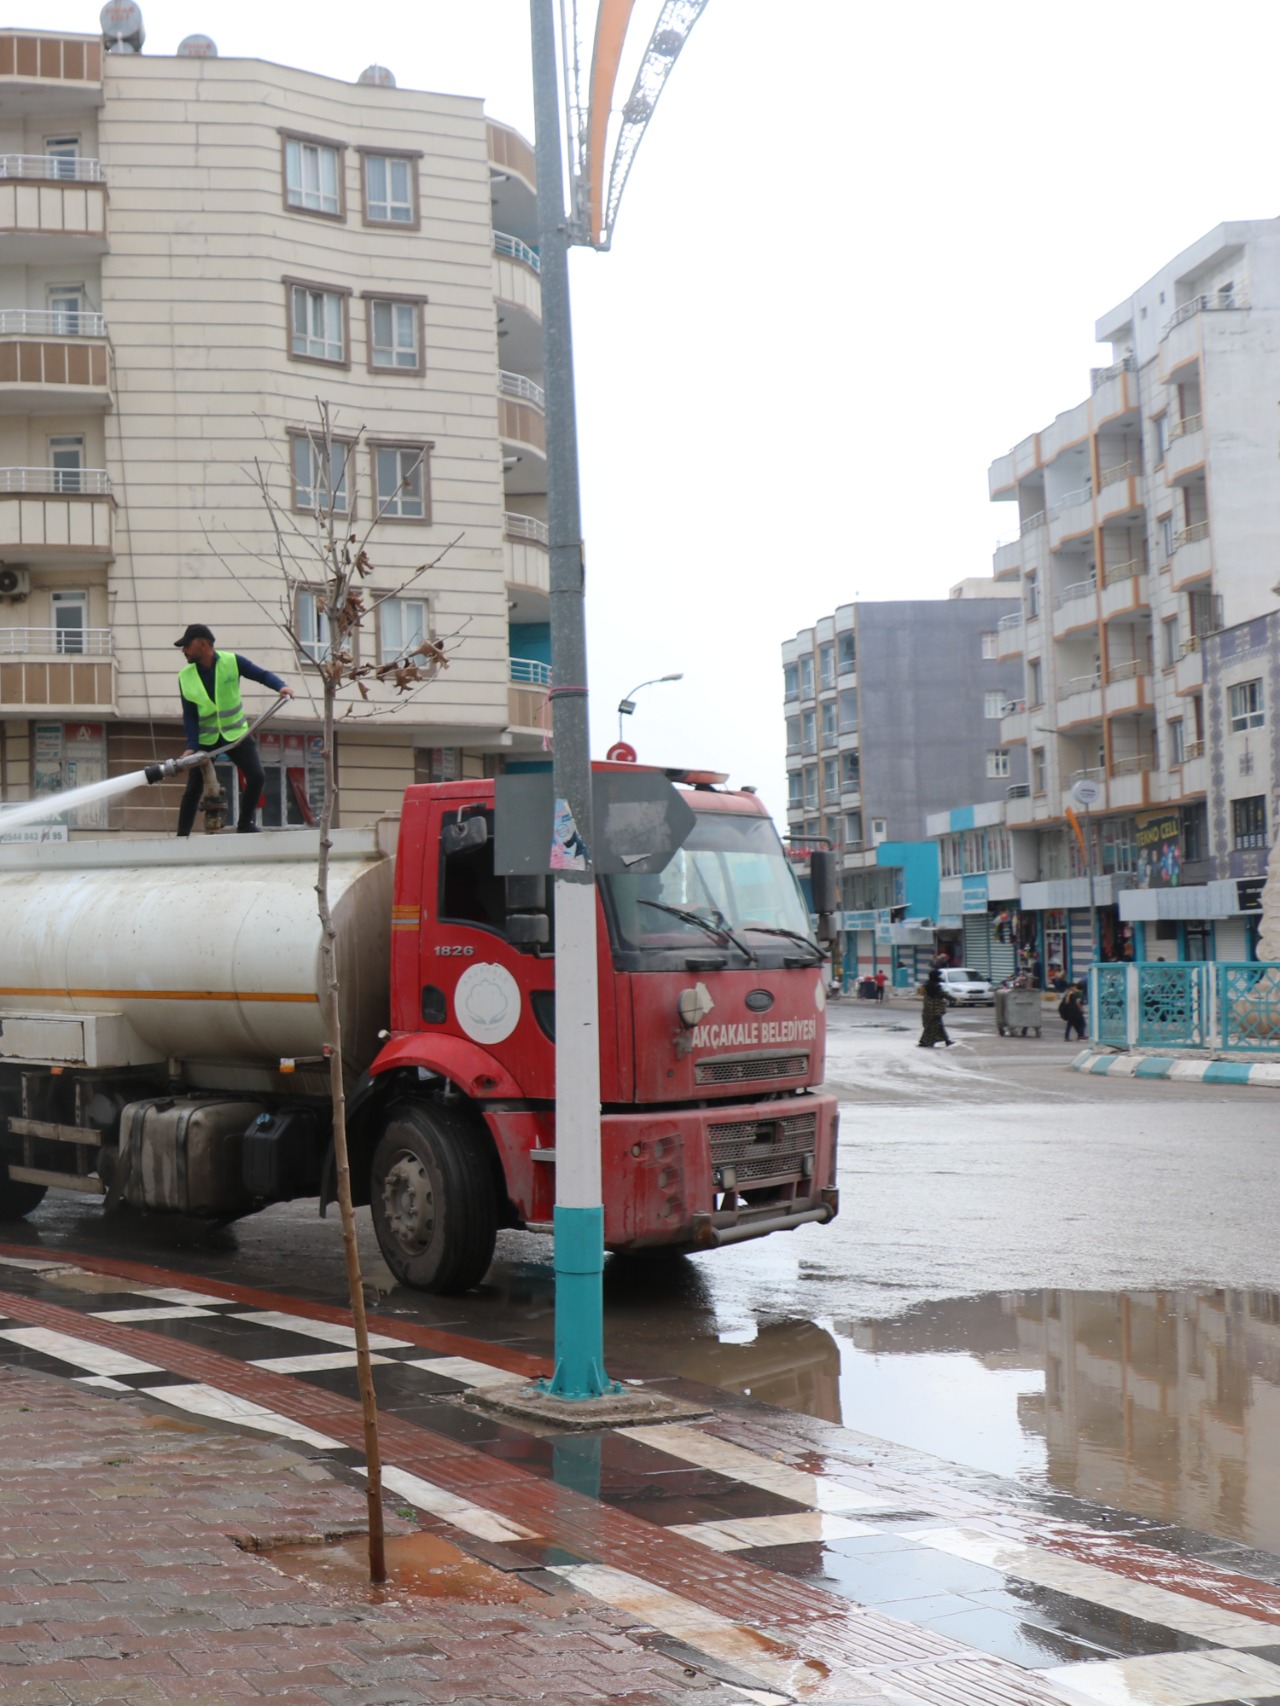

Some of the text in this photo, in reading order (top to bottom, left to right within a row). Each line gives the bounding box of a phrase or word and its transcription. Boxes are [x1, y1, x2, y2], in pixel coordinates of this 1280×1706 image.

[434, 945, 474, 956] 1826
[692, 1014, 816, 1049] AKÇAKALE BELEDİYESİ
